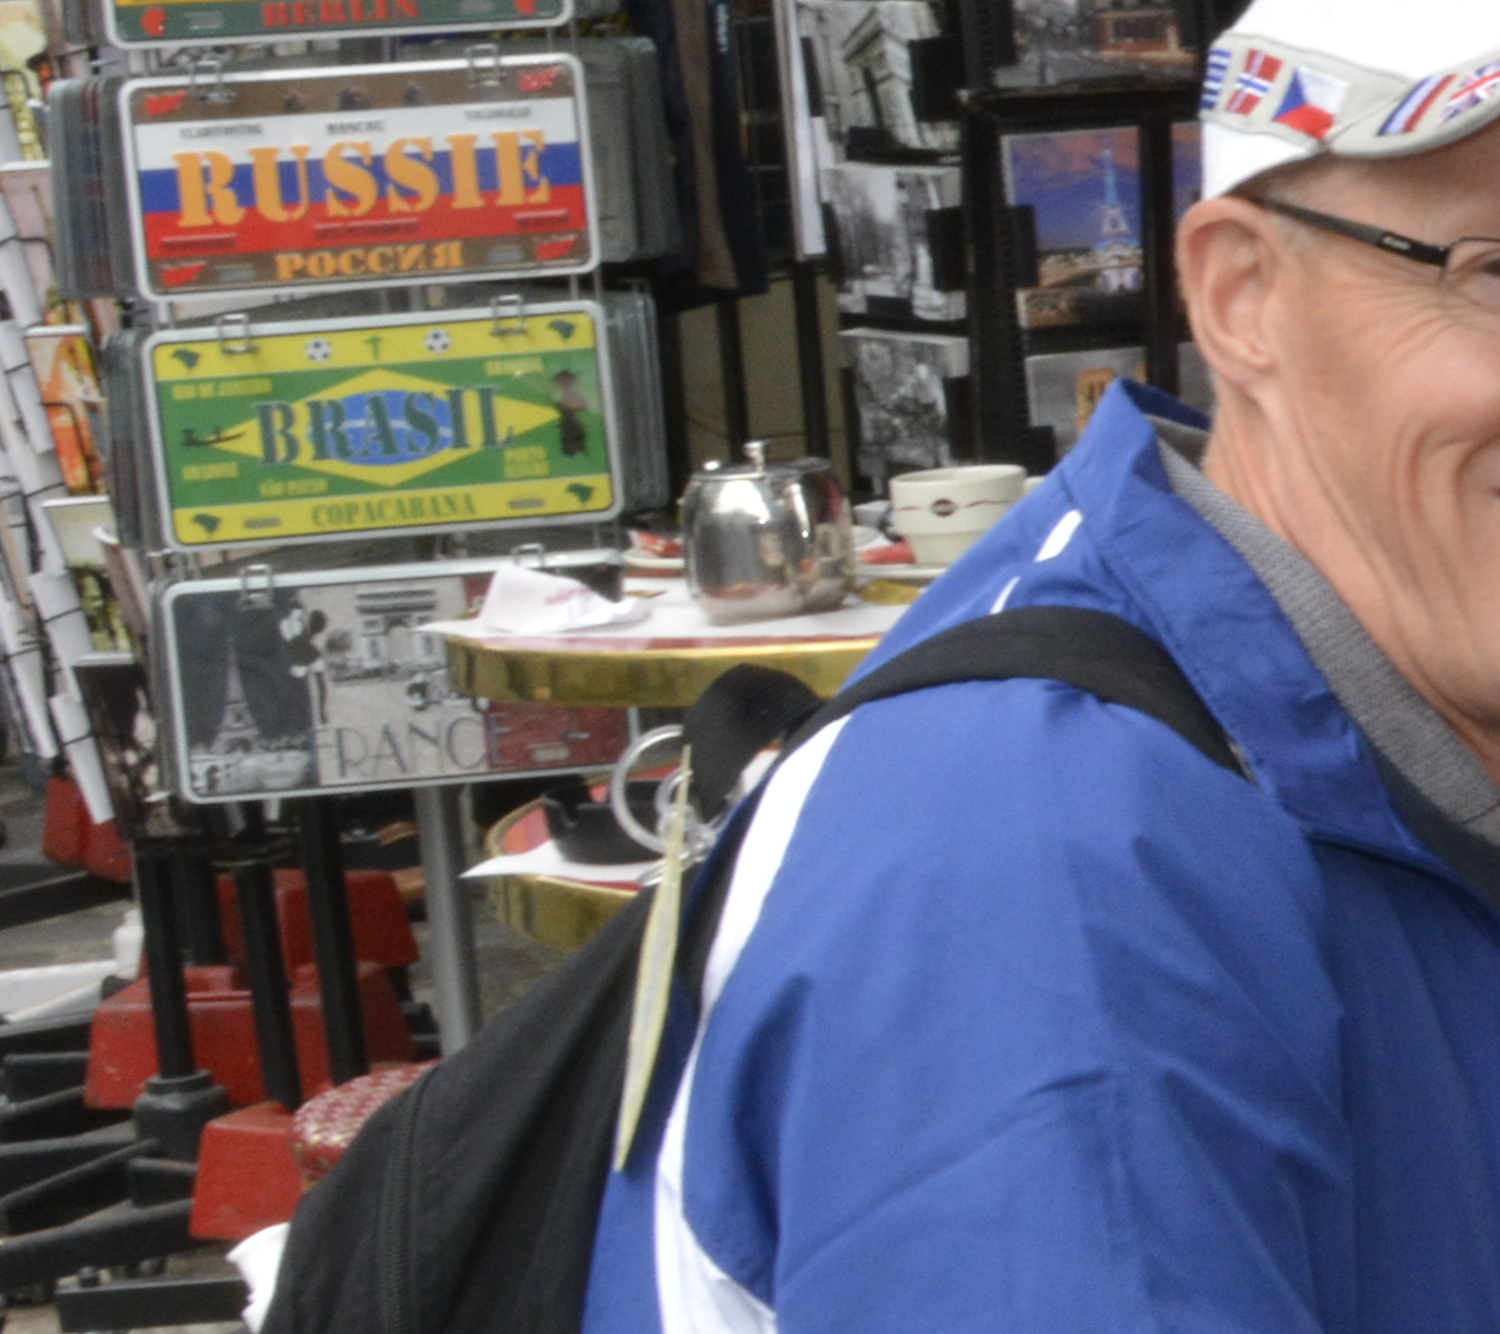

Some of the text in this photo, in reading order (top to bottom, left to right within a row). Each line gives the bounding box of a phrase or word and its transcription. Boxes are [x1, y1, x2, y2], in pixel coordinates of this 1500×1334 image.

[171, 128, 551, 228] RUSSIE
[274, 240, 465, 281] РОССИЯ
[253, 385, 517, 467] BRASIL
[311, 493, 476, 527] COPACABANA
[308, 711, 514, 783] FRANCE
